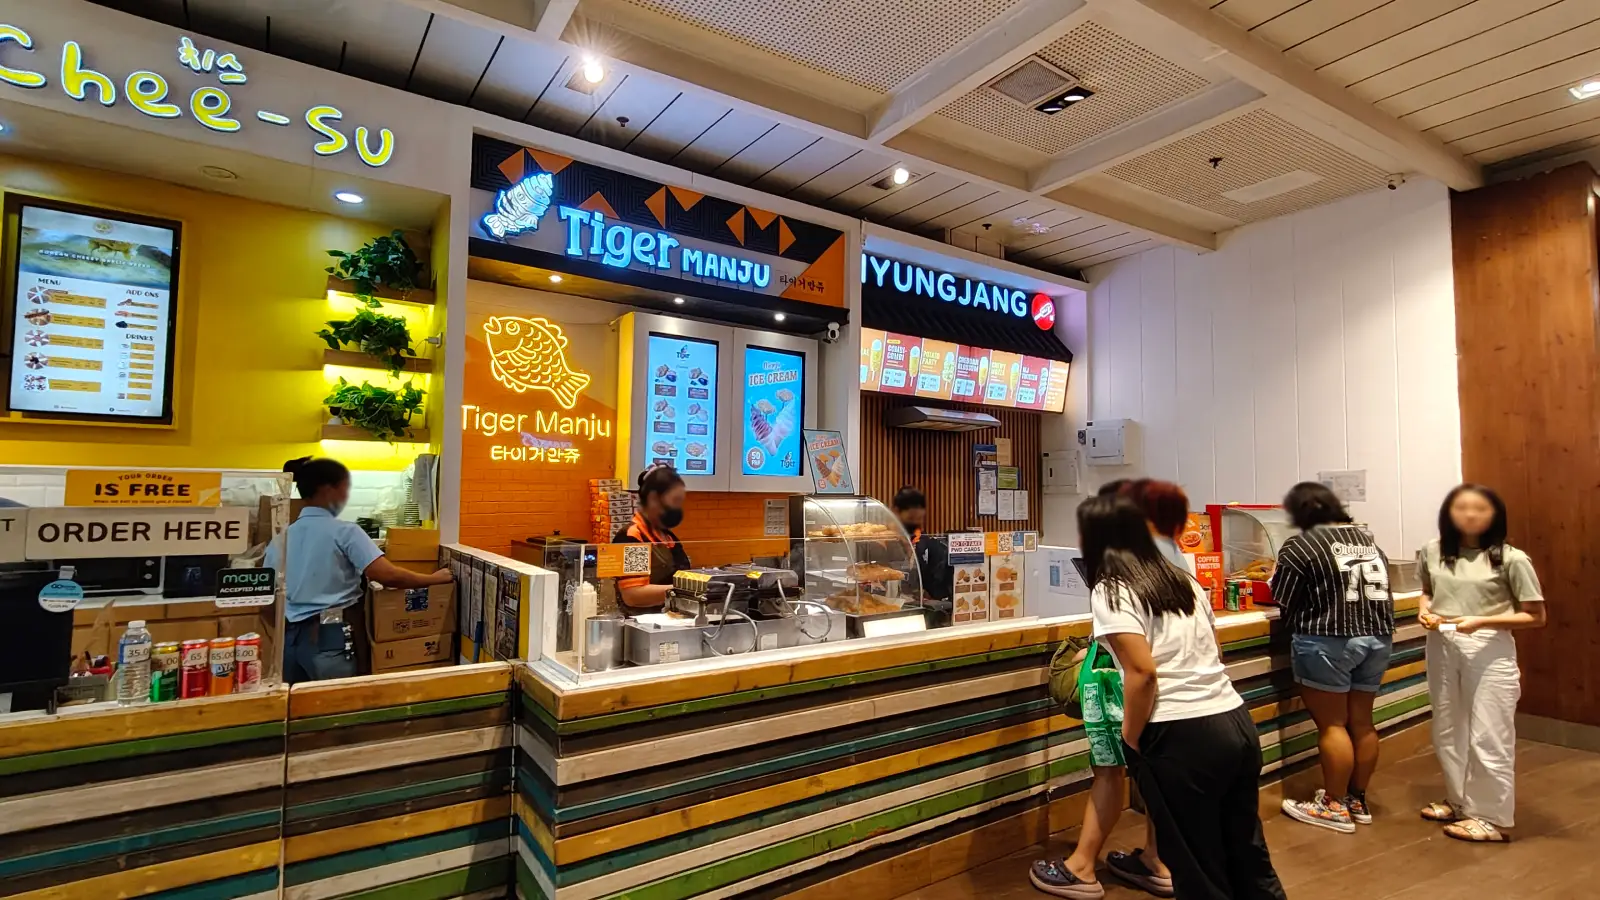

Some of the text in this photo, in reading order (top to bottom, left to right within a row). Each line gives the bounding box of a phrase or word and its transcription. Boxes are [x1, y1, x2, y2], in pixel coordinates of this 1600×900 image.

[558, 204, 770, 288] Tiger MANJU
[38, 277, 61, 286] MENU
[861, 253, 1028, 318] YUNGJANG
[126, 333, 154, 341] DRINKS
[749, 370, 798, 386] ICE CREAM
[461, 404, 528, 437] Tiger
[535, 410, 611, 441] Manju
[751, 451, 761, 460] 50
[118, 472, 173, 482] YOUR ORDER
[94, 483, 191, 497] IS FREE
[37, 520, 241, 543] ORDER HERE
[1331, 541, 1379, 559] Original
[1197, 555, 1220, 563] COFFEE
[222, 573, 270, 585] maya
[1334, 556, 1389, 601] 79
